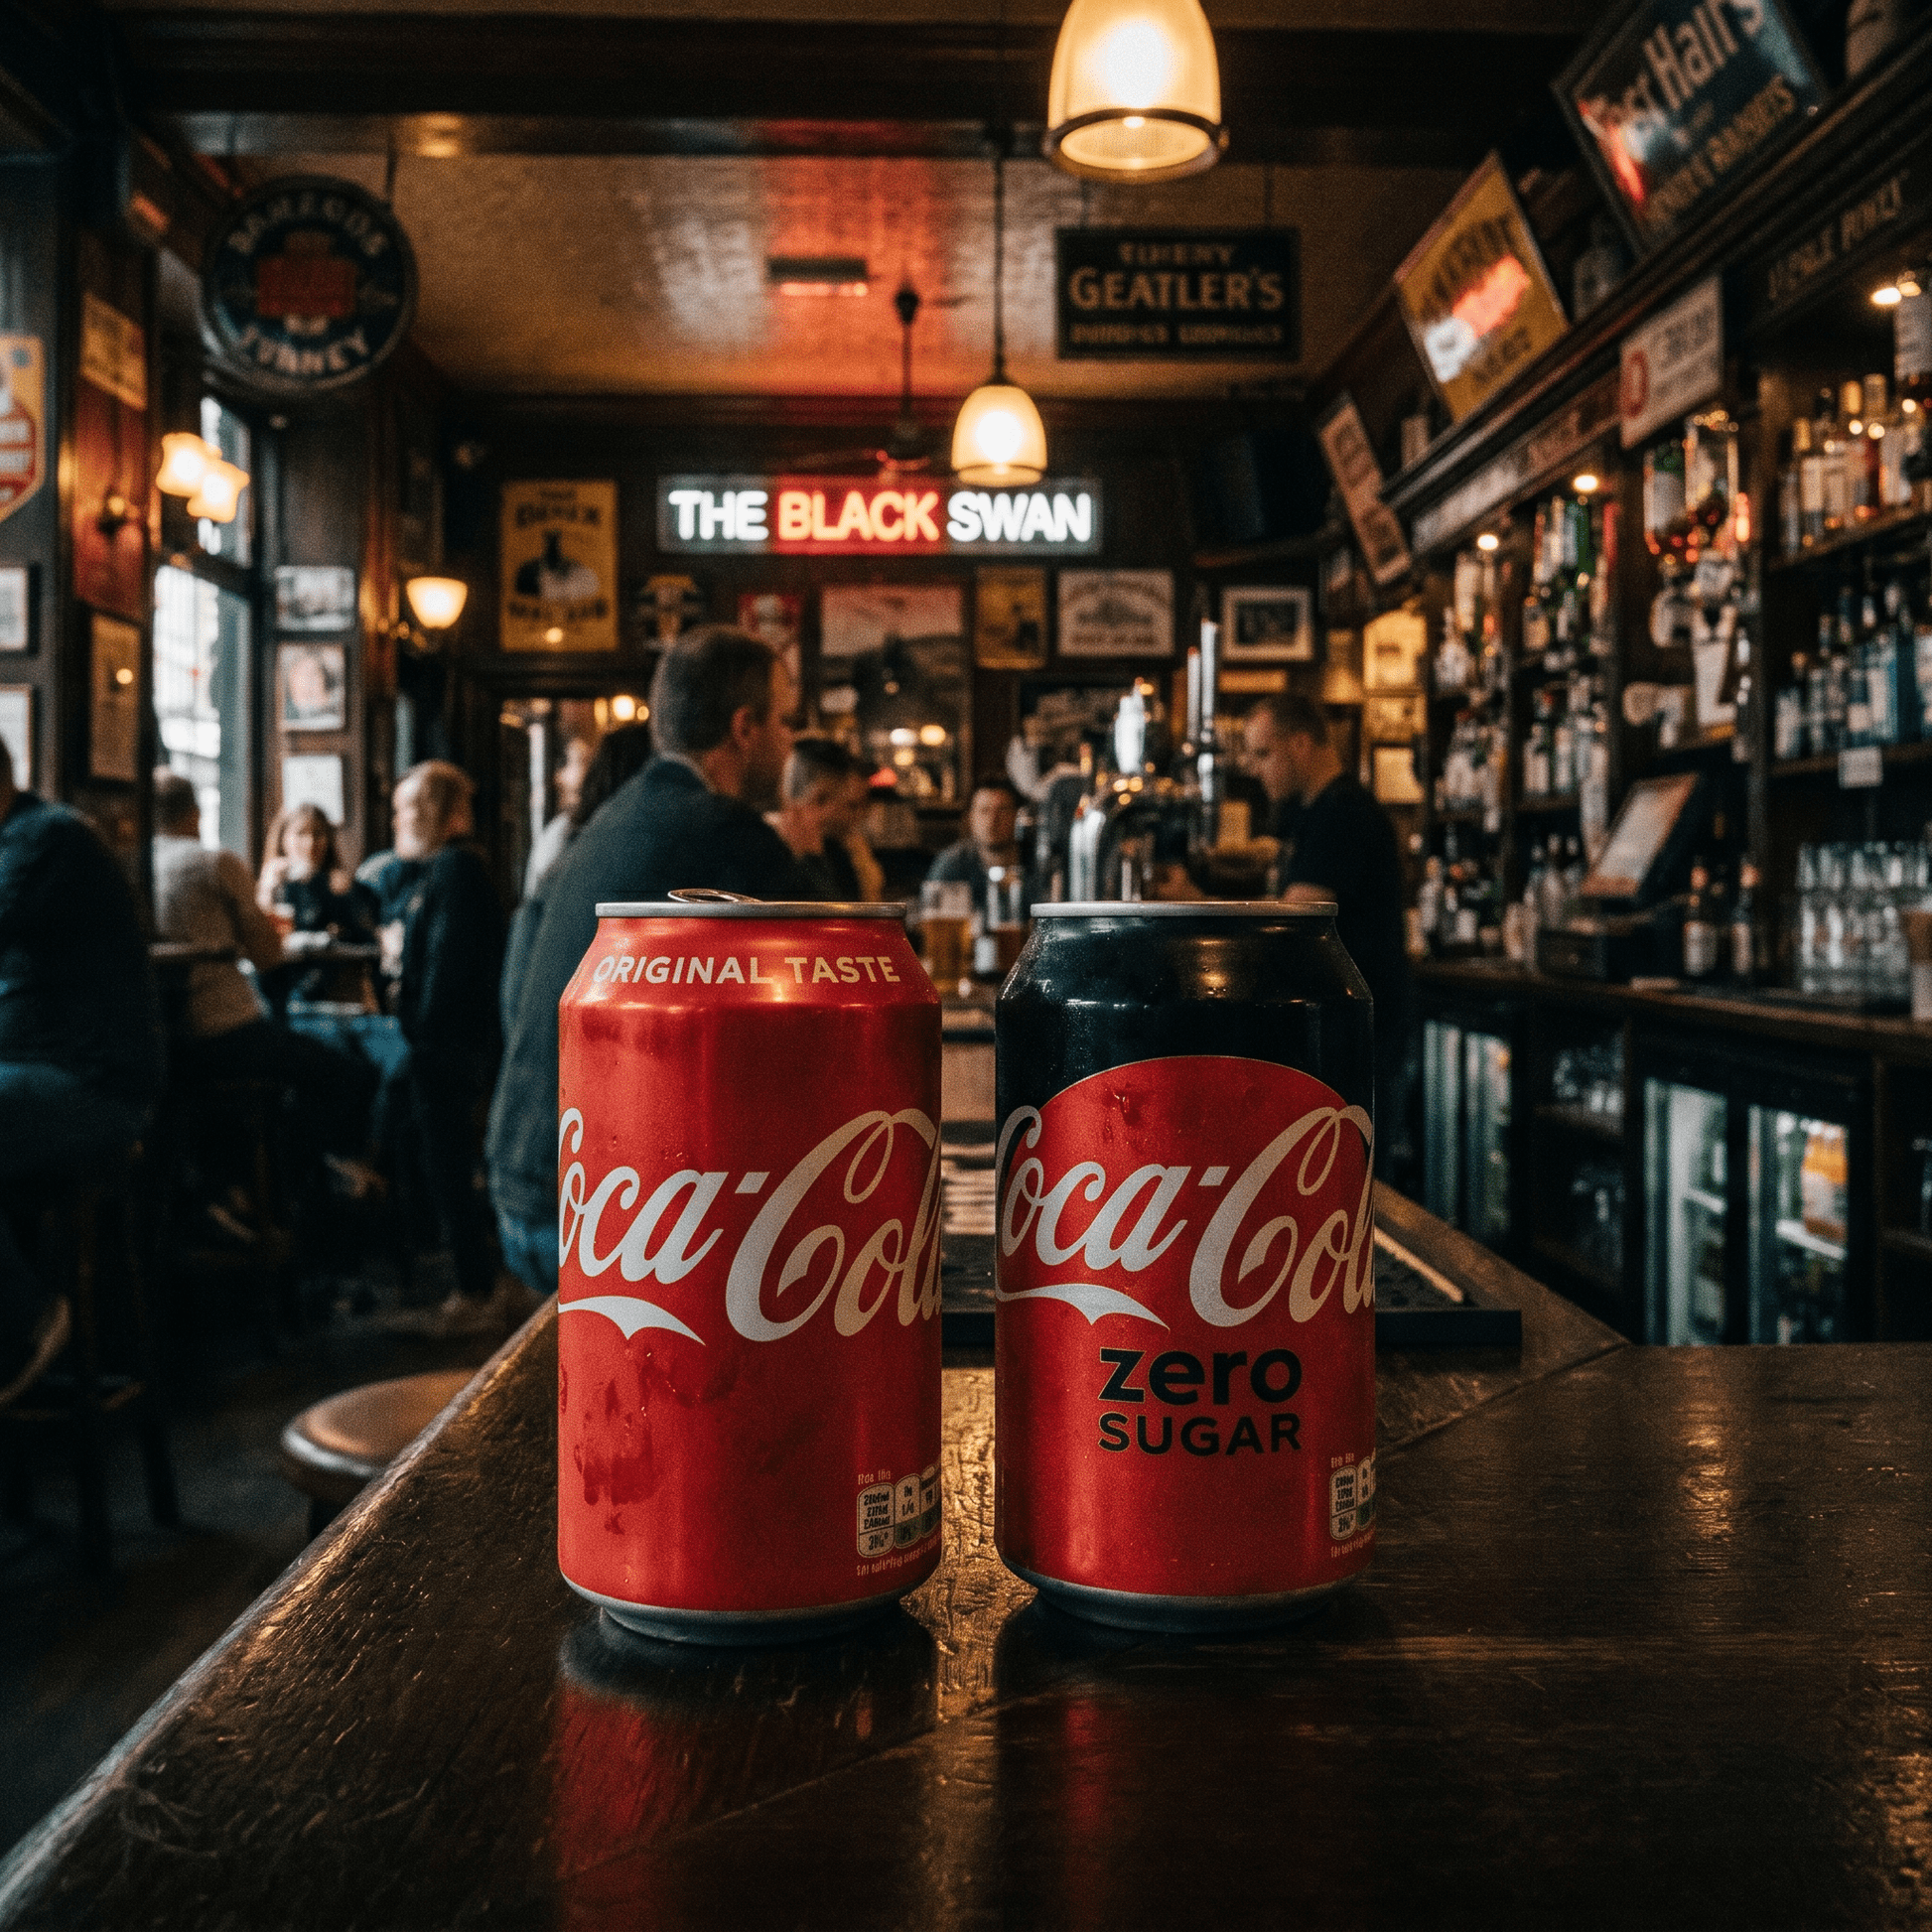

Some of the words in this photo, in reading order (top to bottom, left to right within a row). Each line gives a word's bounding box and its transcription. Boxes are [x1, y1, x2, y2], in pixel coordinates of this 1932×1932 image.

[668, 489, 768, 540] THE
[777, 490, 941, 541] BLACK
[947, 492, 1092, 542] SWAN
[592, 956, 774, 984] ORIGINAL
[784, 956, 900, 984] TASTE
[558, 1107, 942, 1342] oca-Col
[995, 1105, 1375, 1327] Coca-Col
[1098, 1347, 1304, 1406] zero
[1098, 1411, 1303, 1457] SUGAR
